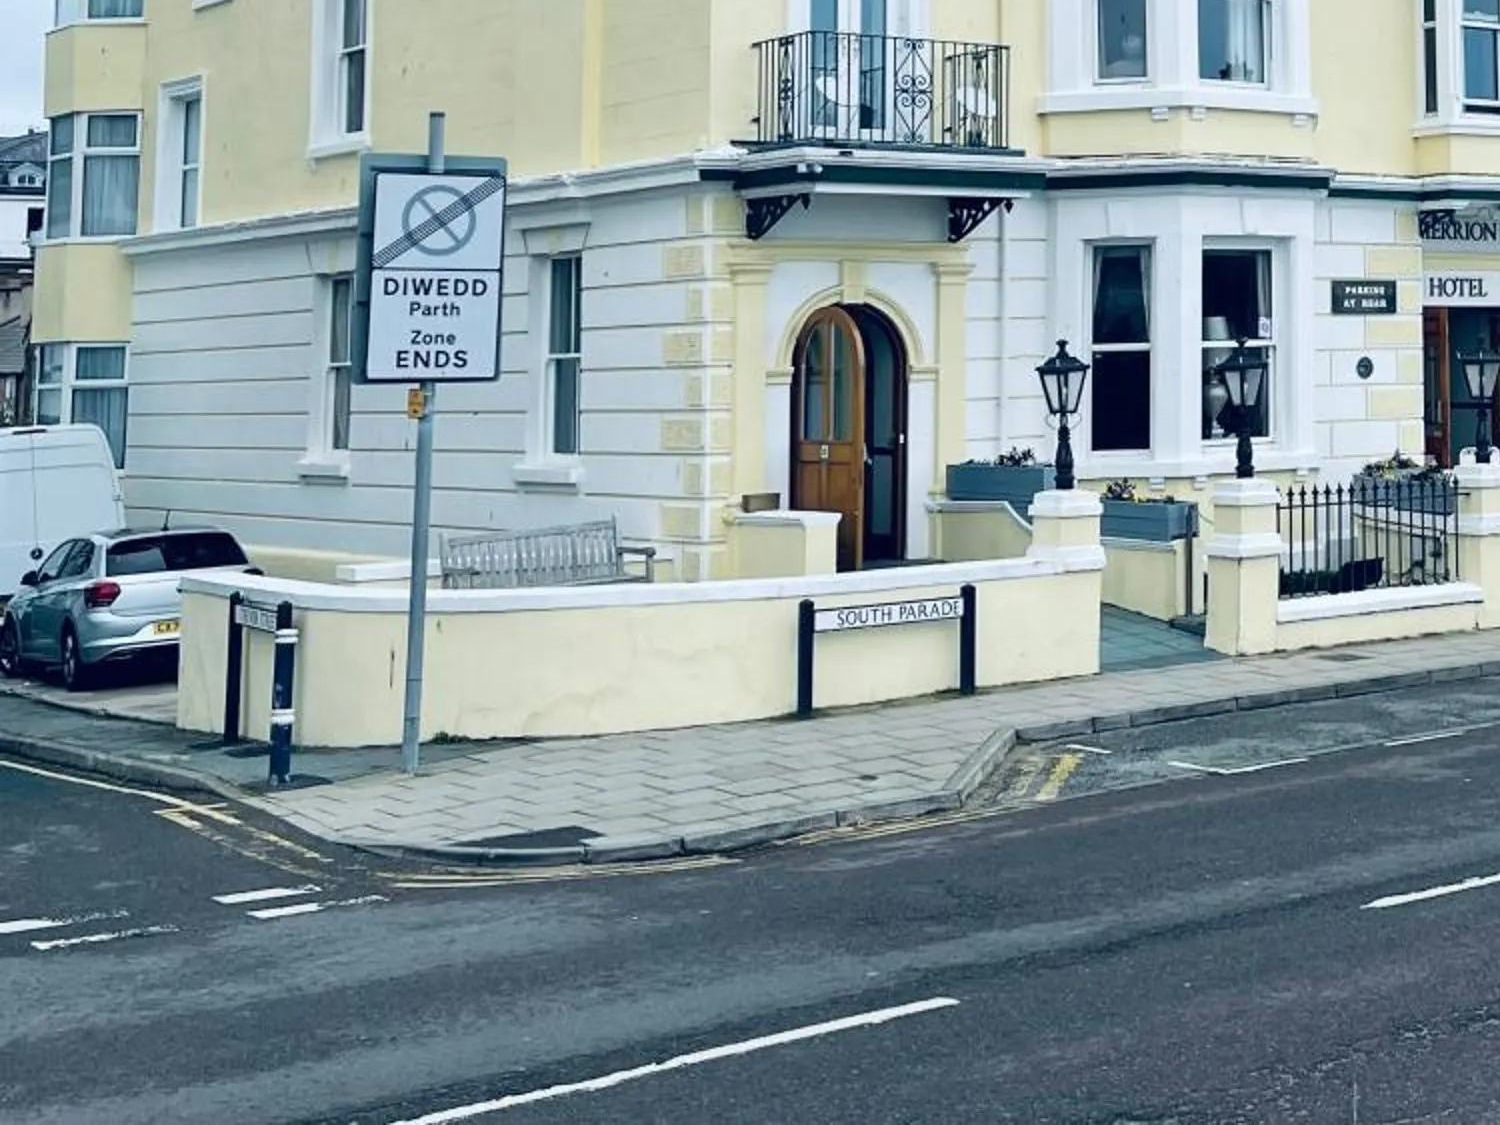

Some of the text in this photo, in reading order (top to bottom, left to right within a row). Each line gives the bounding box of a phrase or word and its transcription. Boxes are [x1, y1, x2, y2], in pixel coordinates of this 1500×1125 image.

[383, 278, 487, 297] DIWEDD
[1429, 277, 1488, 297] HOTEL
[409, 301, 461, 317] Parth
[1343, 298, 1356, 308] AT
[411, 330, 456, 346] Zone
[395, 350, 468, 369] ENDS
[836, 600, 961, 627] SOUTH PARADE
